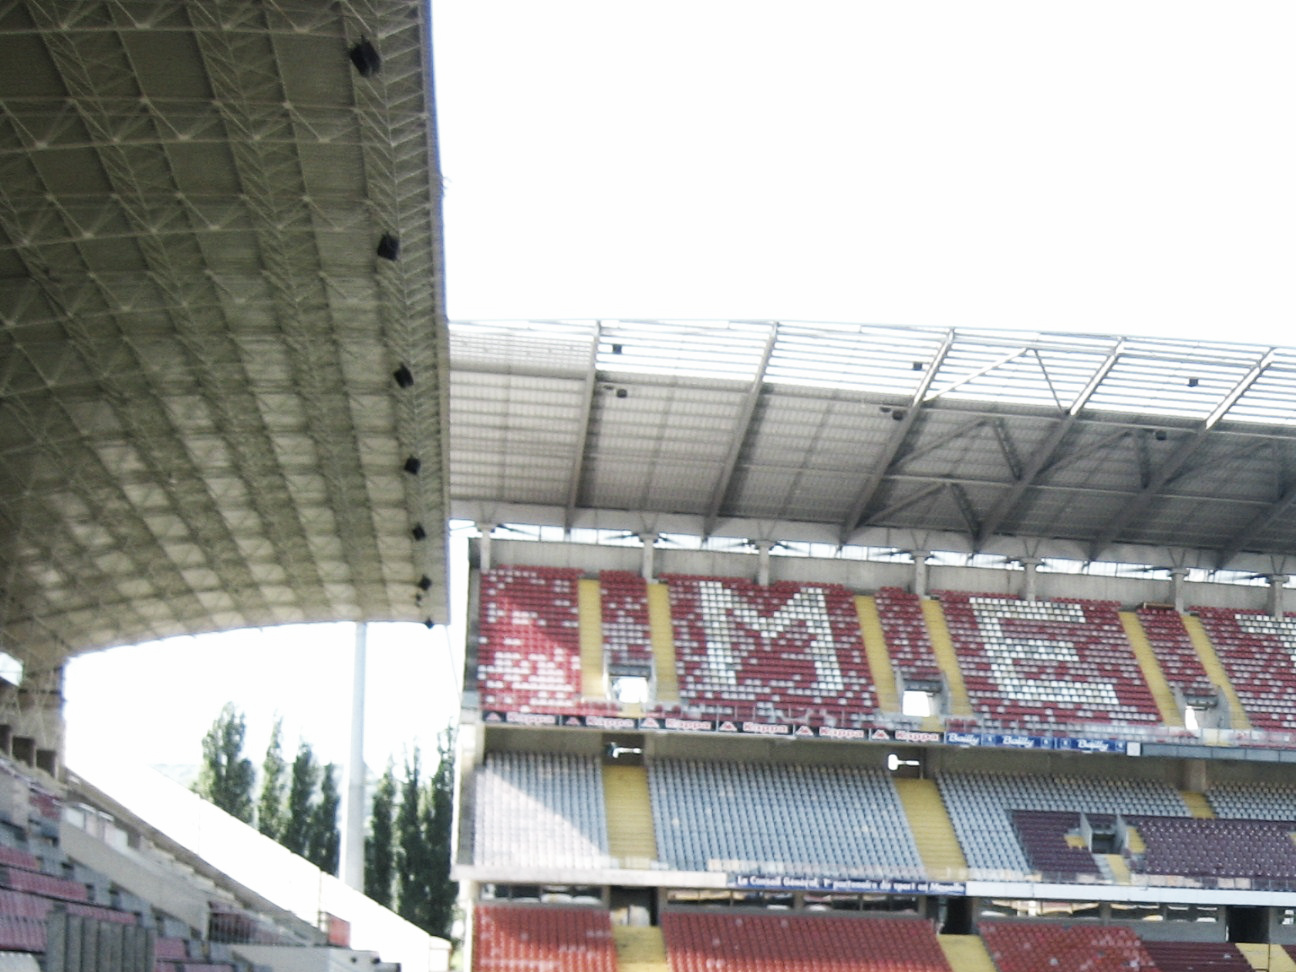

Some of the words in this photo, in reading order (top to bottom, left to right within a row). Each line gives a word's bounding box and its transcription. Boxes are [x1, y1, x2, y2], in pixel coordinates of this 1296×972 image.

[505, 711, 556, 727] Kappa
[585, 715, 635, 730] Kappa
[665, 718, 712, 732] Kappa
[743, 721, 788, 736] Kappa
[819, 726, 864, 740] Kappa
[895, 730, 940, 743] Kappa
